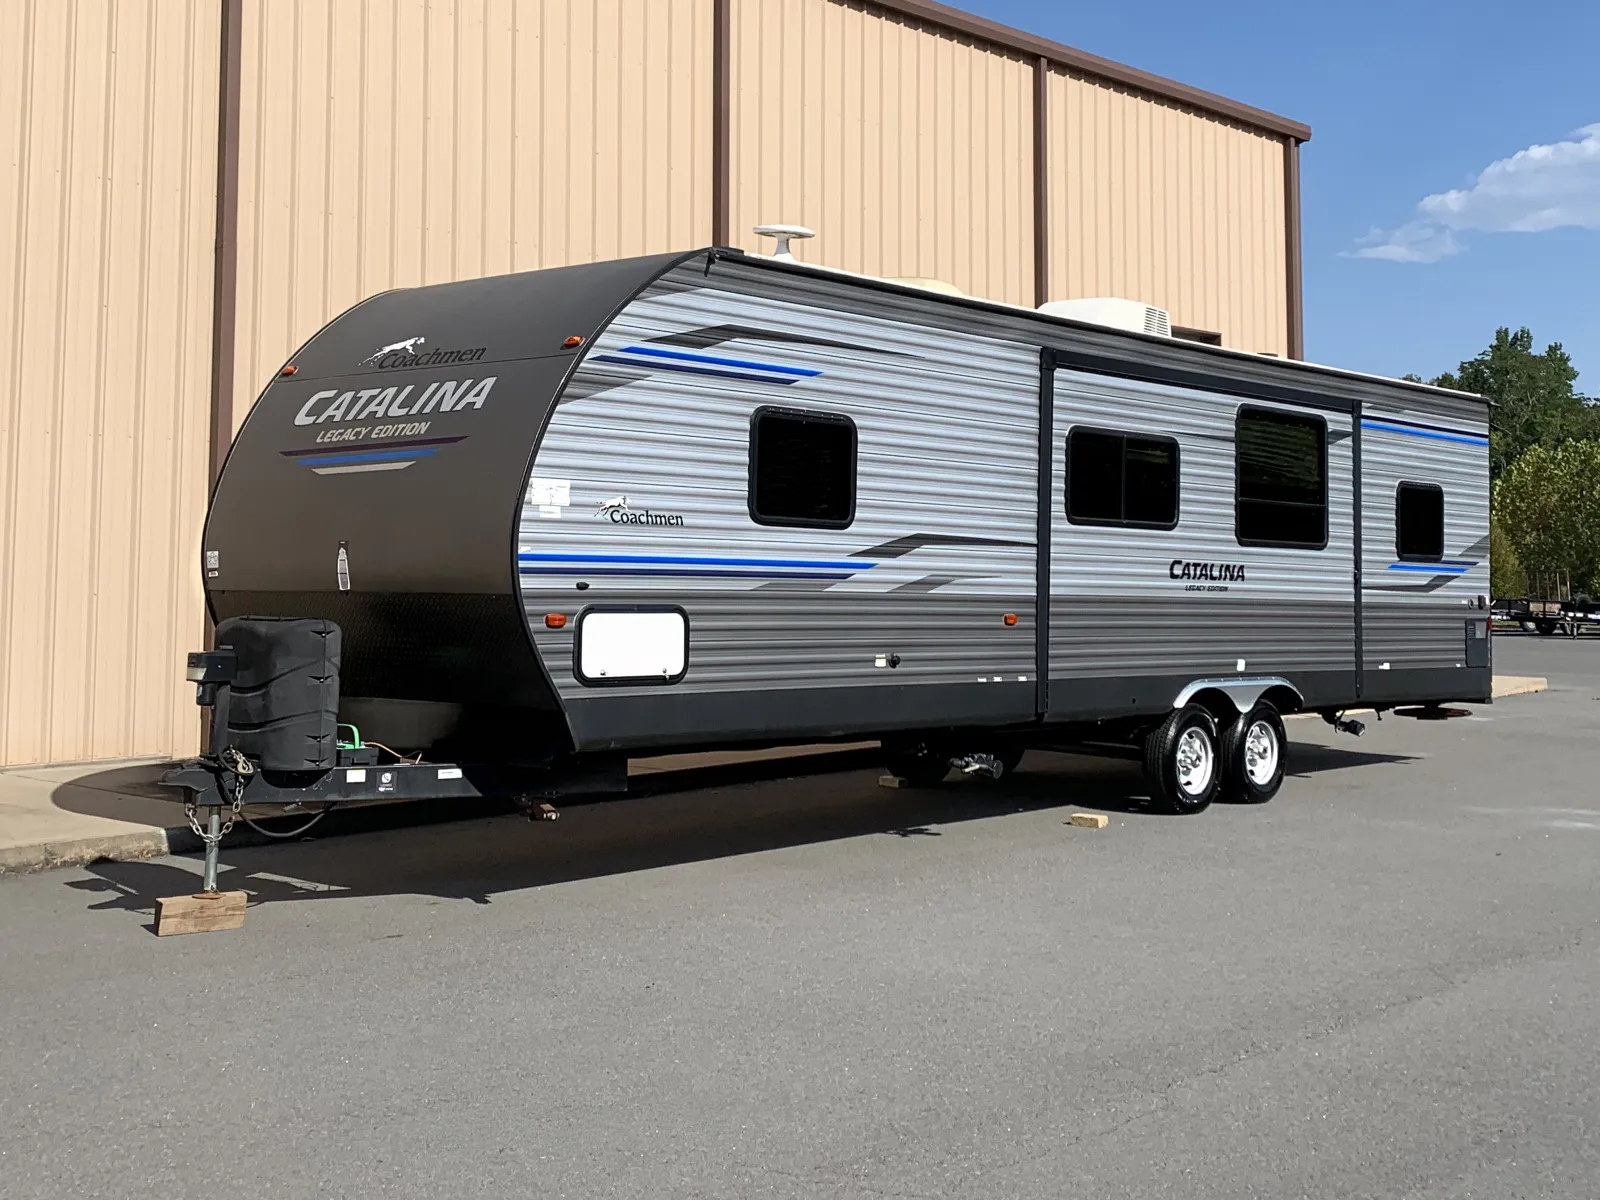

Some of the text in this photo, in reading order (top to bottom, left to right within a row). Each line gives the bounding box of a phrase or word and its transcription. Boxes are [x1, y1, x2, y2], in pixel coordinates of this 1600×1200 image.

[378, 347, 487, 370] Coachmen
[293, 376, 498, 426] CATALINA
[316, 421, 431, 443] LEGACY EDITION
[610, 509, 684, 526] Coachmen
[1169, 559, 1245, 582] CATALINA
[1184, 584, 1206, 592] LEGACY
